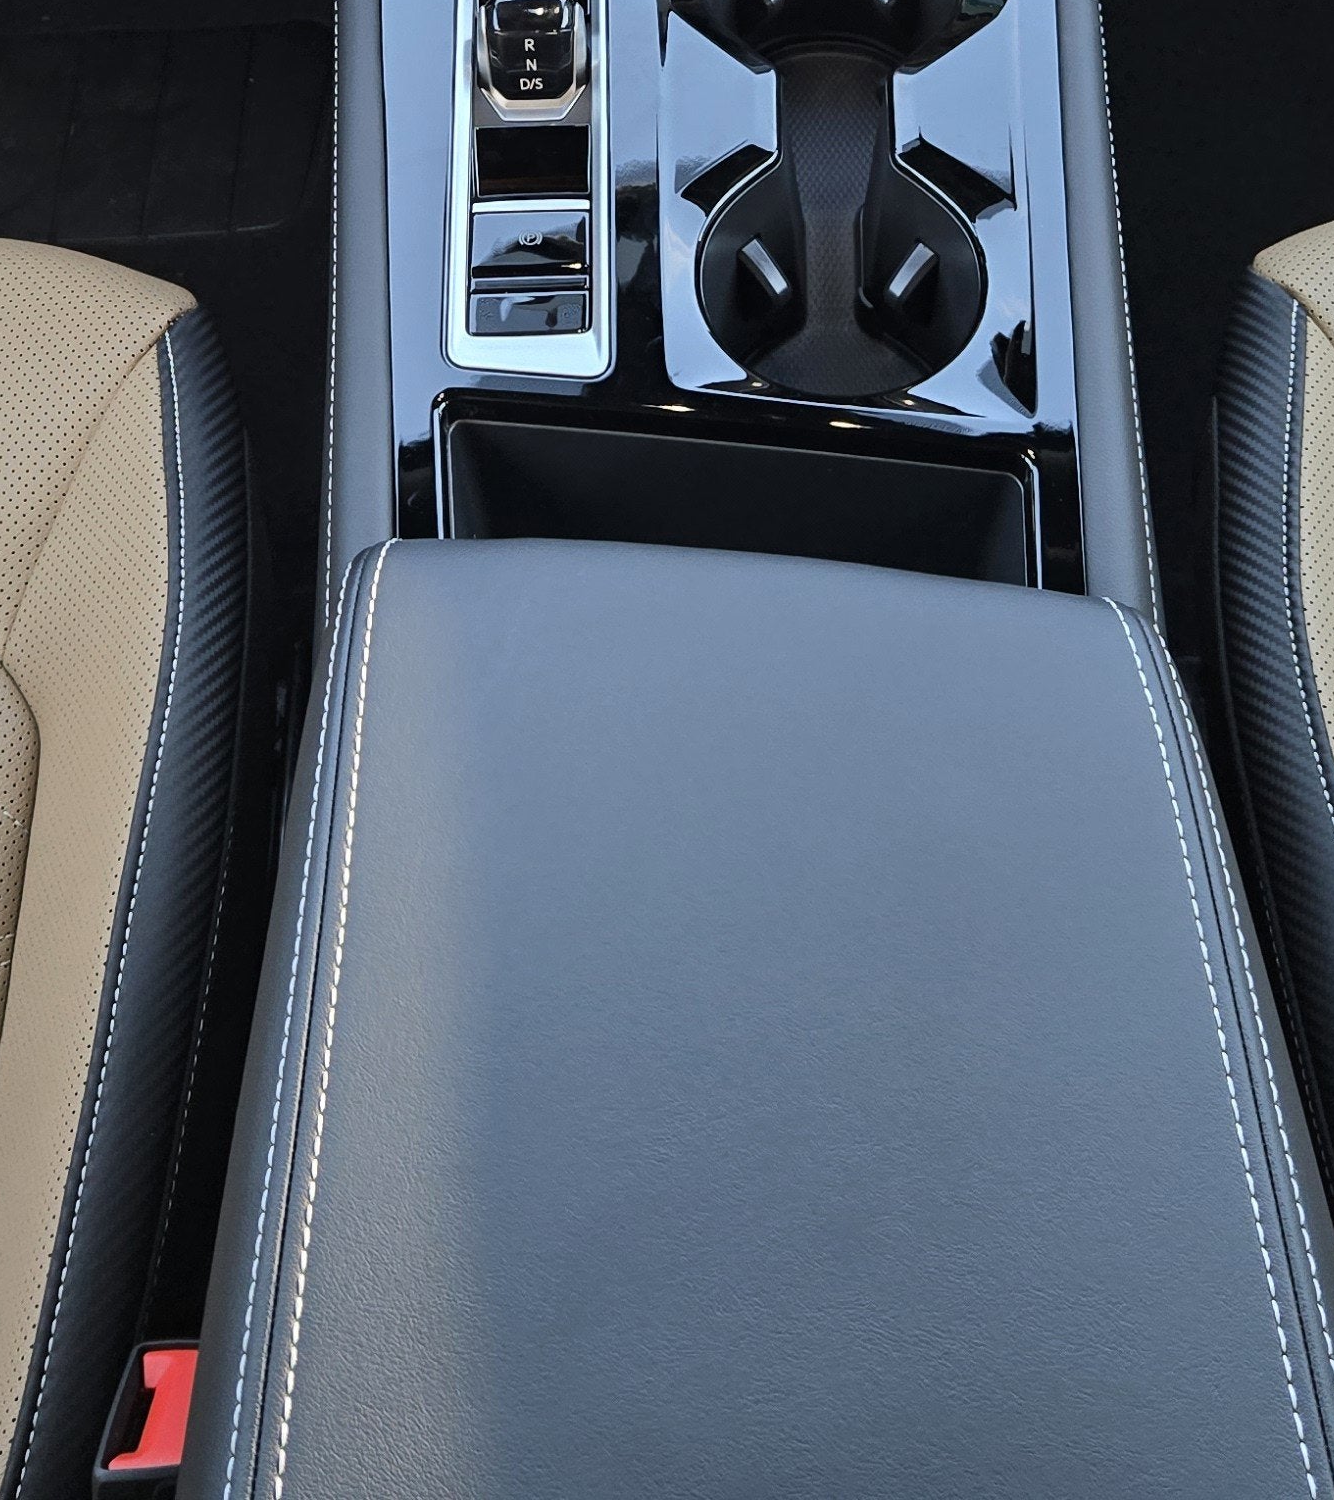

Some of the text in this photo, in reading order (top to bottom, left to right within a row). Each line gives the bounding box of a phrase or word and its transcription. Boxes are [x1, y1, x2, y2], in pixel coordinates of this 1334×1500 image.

[524, 38, 535, 52] R
[525, 58, 538, 72] N
[519, 77, 544, 90] D/S
